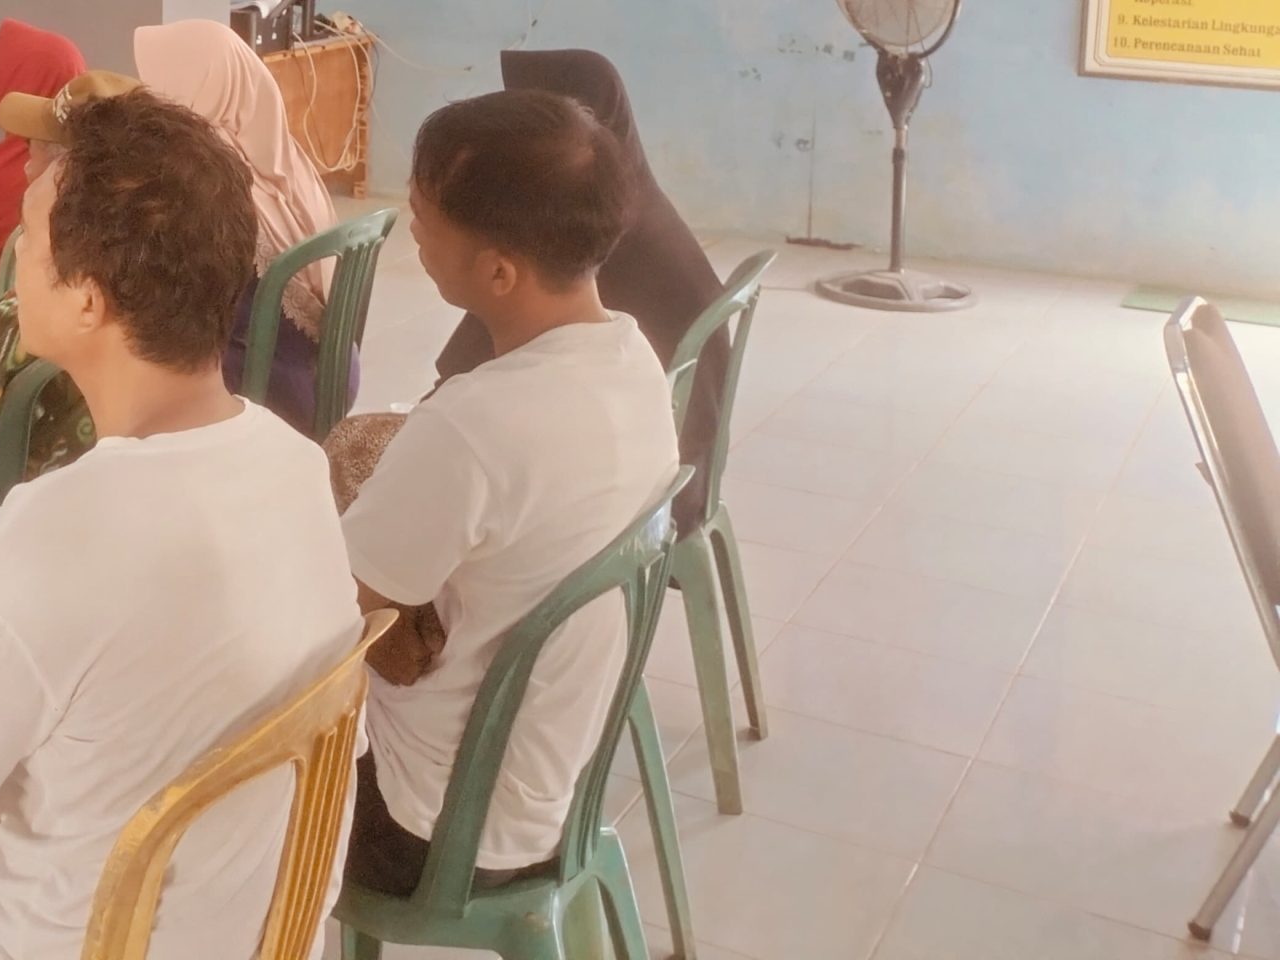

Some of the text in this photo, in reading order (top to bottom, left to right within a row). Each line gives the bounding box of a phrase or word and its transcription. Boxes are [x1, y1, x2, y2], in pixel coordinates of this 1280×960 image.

[1132, 15, 1208, 30] Kelestarian
[1134, 37, 1220, 54] Perencanaan
[1222, 44, 1261, 58] Sehat
